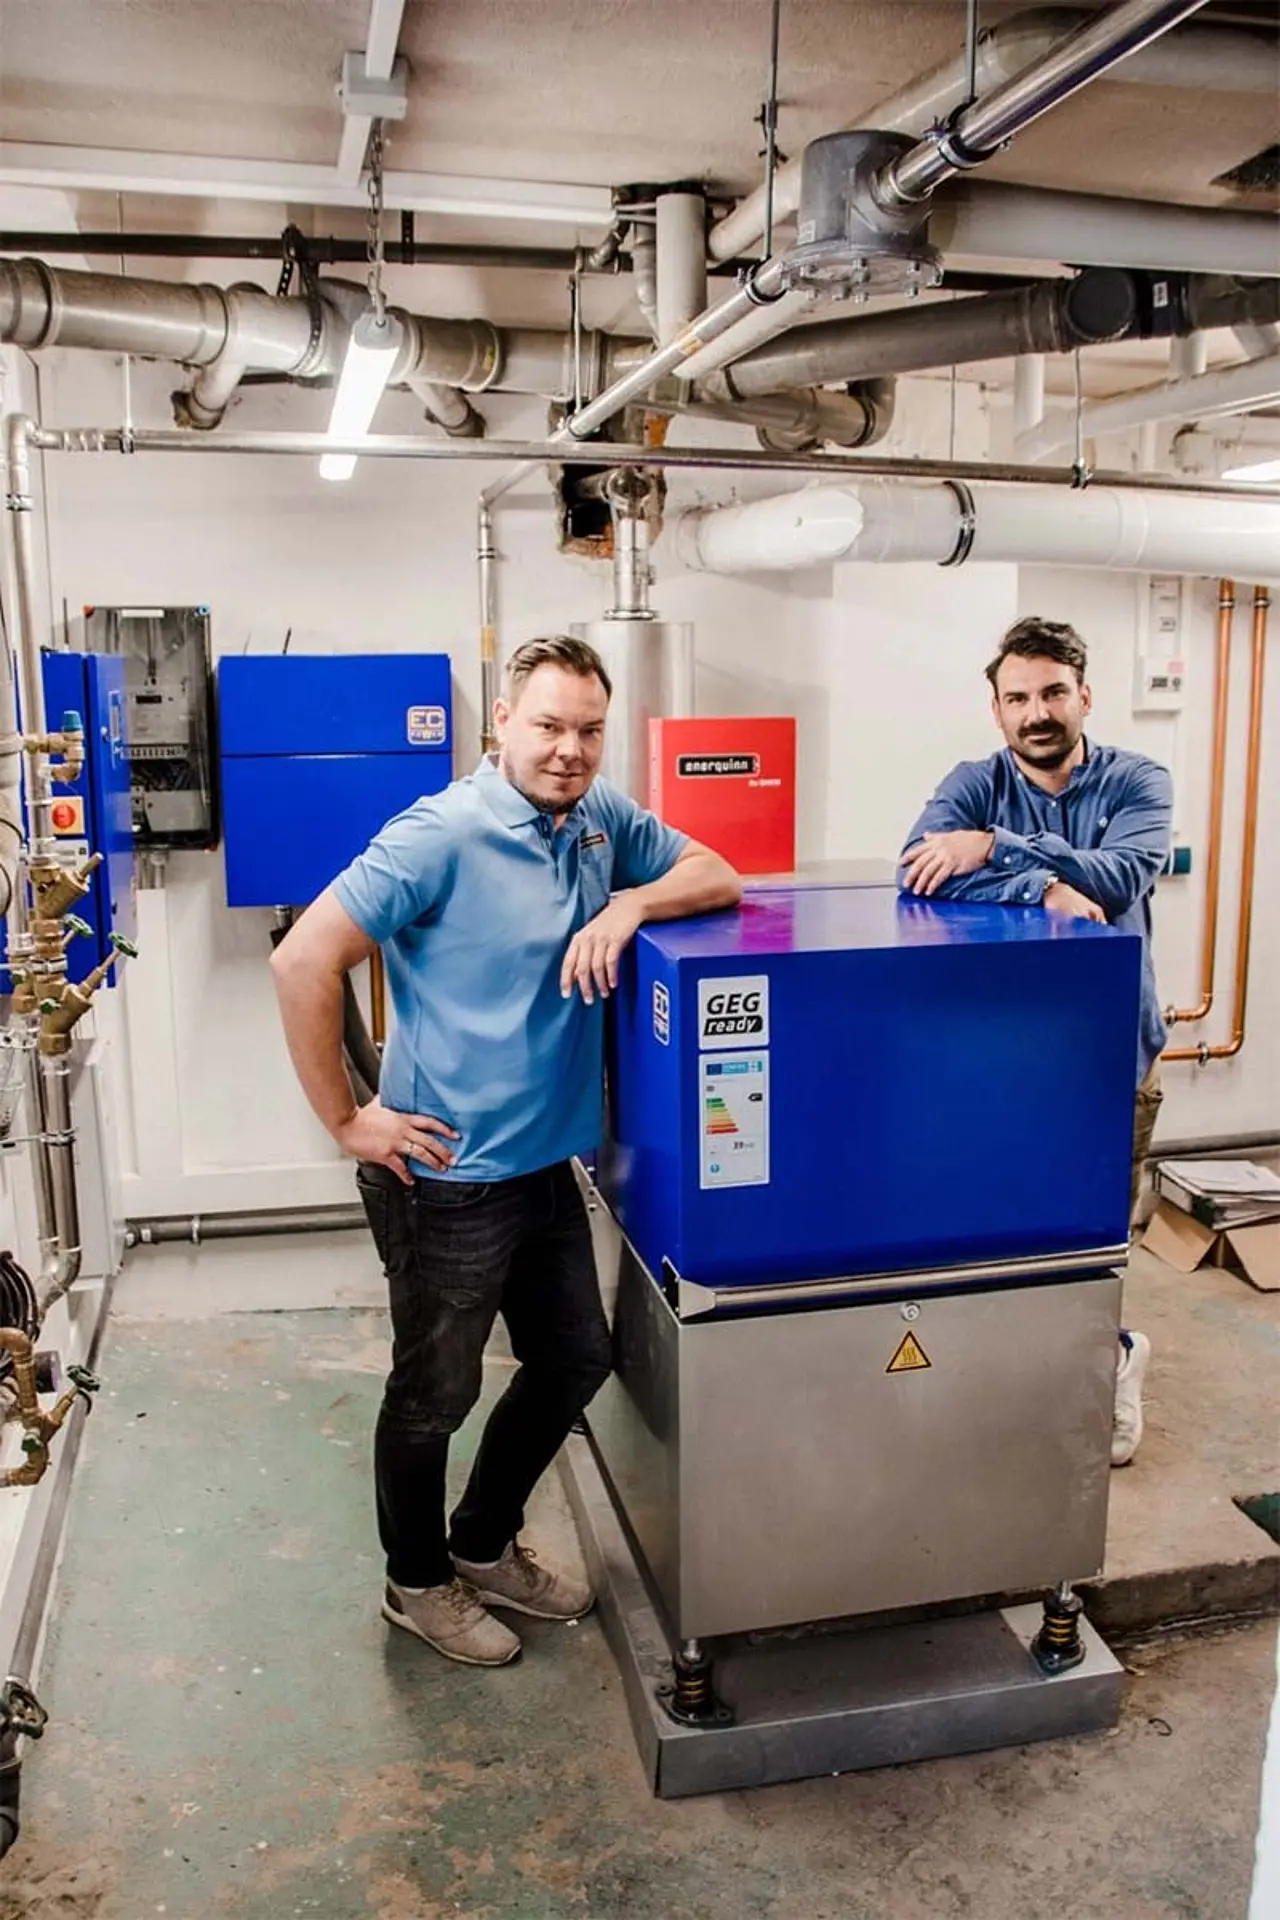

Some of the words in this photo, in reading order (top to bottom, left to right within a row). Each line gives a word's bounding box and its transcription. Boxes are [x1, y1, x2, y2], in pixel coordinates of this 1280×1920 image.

[684, 758, 748, 773] enerquinn
[707, 992, 761, 1015] GEG
[707, 1016, 757, 1033] ready
